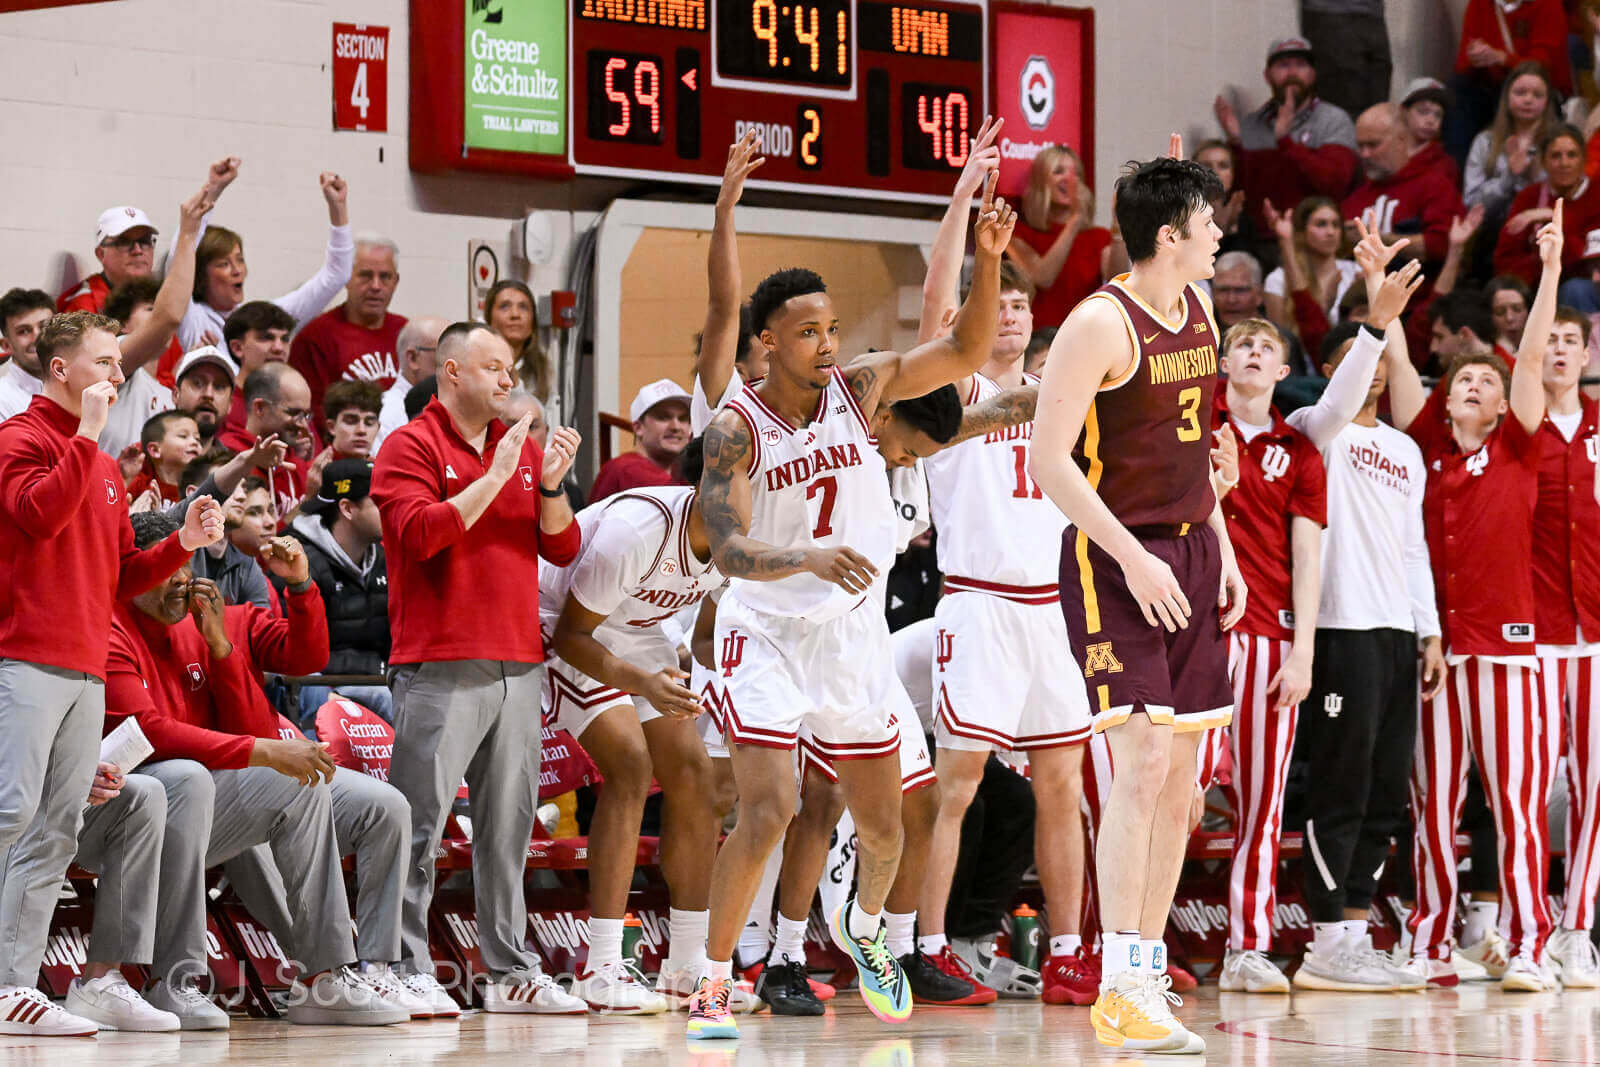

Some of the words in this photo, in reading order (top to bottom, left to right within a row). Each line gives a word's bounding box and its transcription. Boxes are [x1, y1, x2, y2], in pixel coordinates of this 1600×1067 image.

[336, 32, 385, 61] SECTION
[471, 28, 540, 65] Greene
[752, 0, 847, 75] 9:41
[350, 62, 370, 119] 4
[605, 57, 660, 136] 59
[482, 114, 512, 131] TRIAL
[513, 117, 560, 136] LAWYERS
[800, 109, 820, 166] 2
[918, 92, 969, 167] 40
[1148, 344, 1218, 385] MINNESOTA
[1176, 386, 1202, 443] 3
[765, 443, 862, 492] INDIANA
[806, 475, 838, 540] 7
[340, 718, 389, 738] German
[527, 911, 592, 957] HyVe
